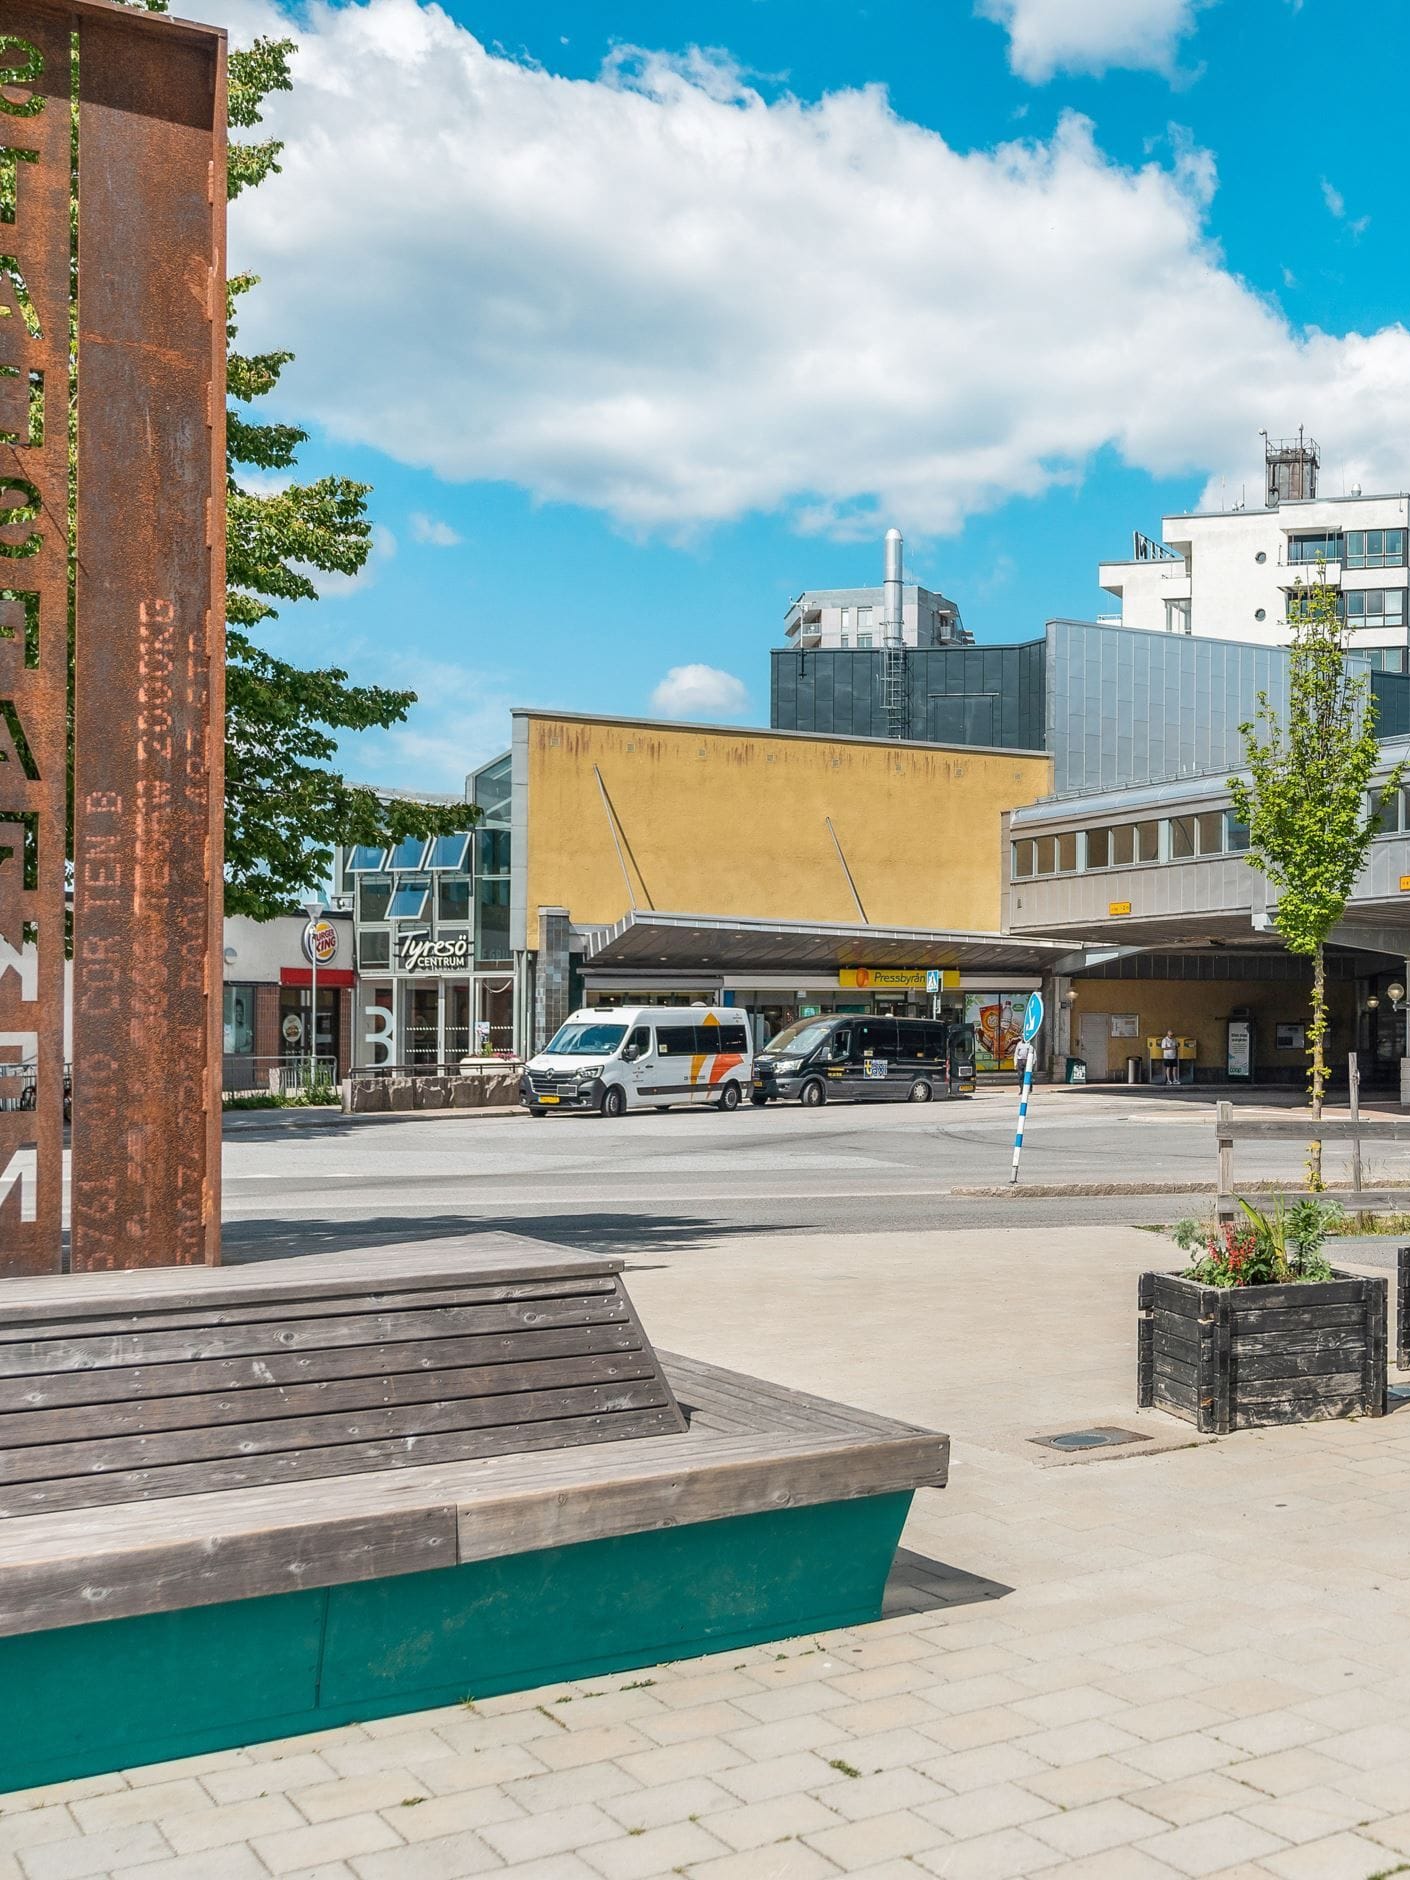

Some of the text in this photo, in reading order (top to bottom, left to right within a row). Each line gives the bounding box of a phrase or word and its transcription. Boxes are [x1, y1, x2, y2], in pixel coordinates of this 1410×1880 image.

[86, 790, 122, 814] B
[84, 835, 122, 912] TEN
[398, 930, 467, 970] Tyresö
[417, 957, 465, 967] CENTRUM
[80, 935, 121, 1012] COR
[874, 972, 925, 988] Pressbyrån
